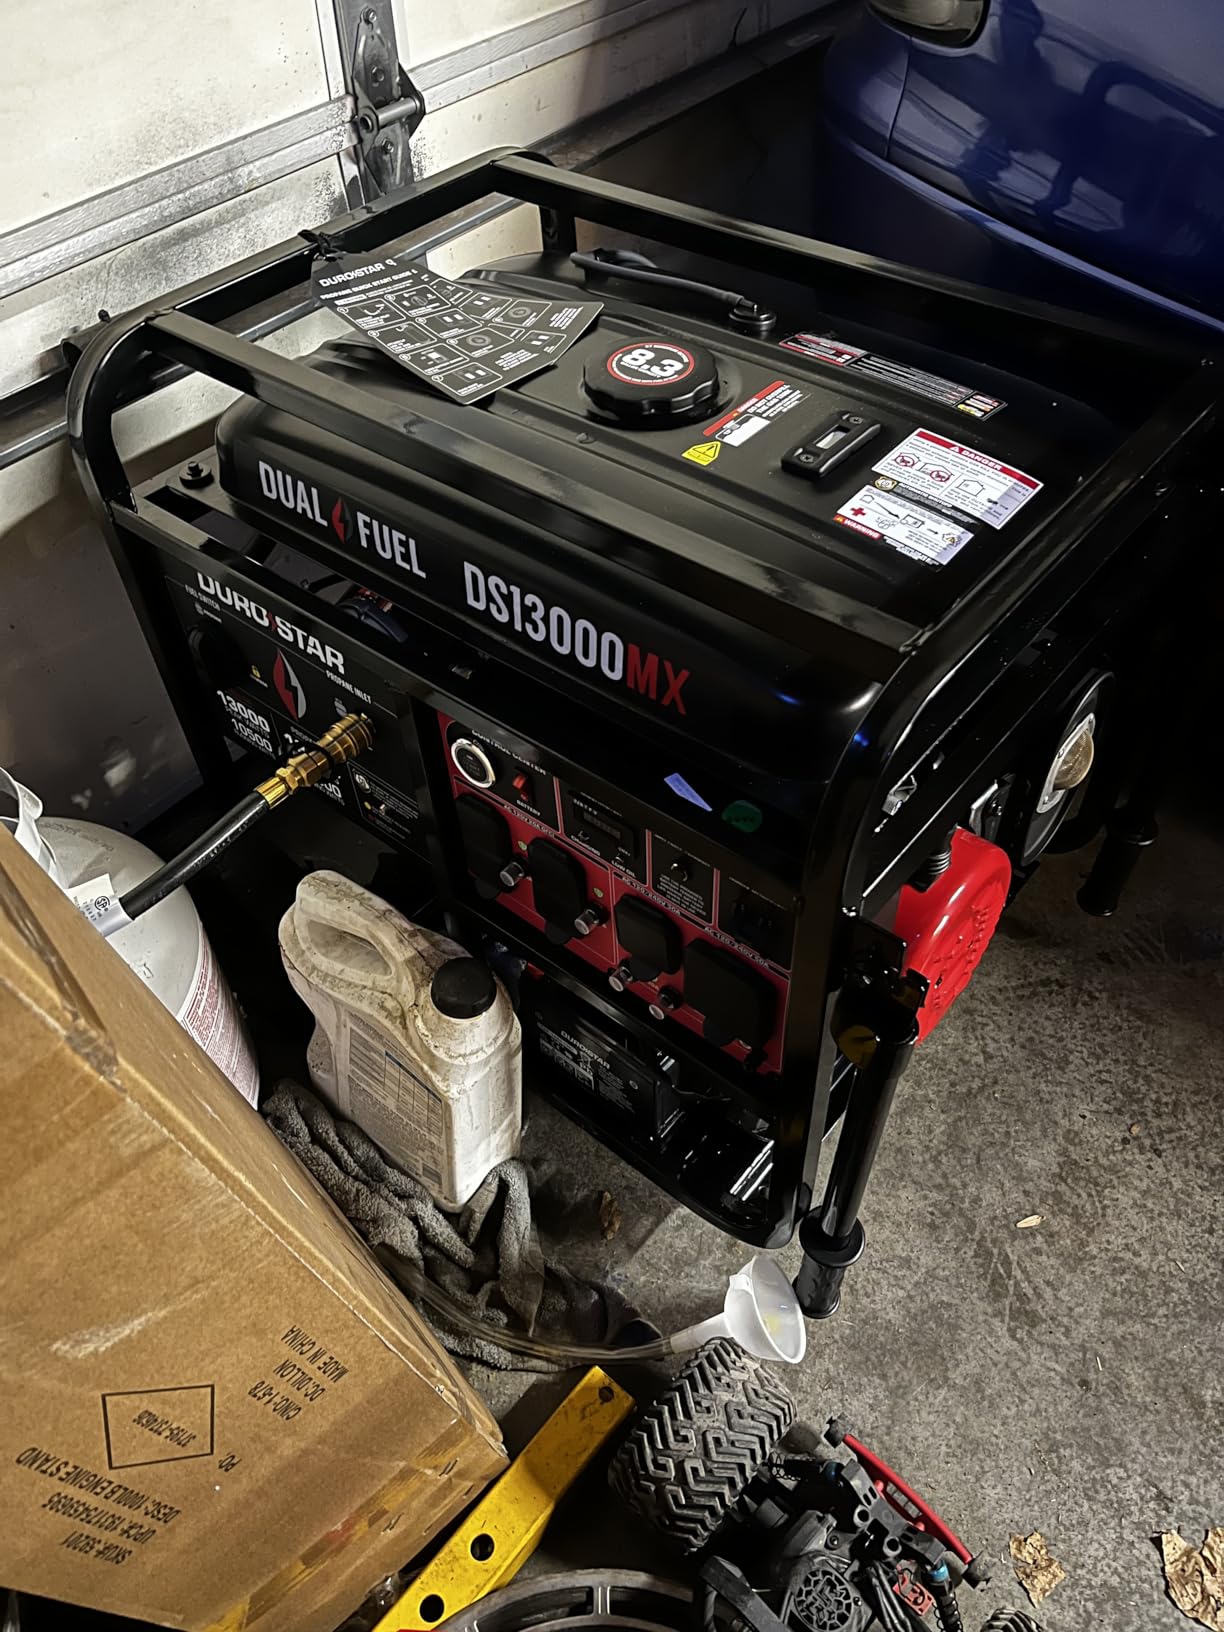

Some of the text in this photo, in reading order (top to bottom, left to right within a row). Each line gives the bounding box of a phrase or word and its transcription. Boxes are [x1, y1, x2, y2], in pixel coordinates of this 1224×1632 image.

[621, 348, 683, 377] 8.3
[961, 449, 1002, 471] DANGER
[259, 460, 425, 579] DUAL FUEL
[842, 519, 880, 538] WARNING
[464, 559, 691, 716] DS13000MX
[218, 688, 269, 733] 13000
[280, 1324, 349, 1383] MADE IN CHINA
[247, 1379, 279, 1406] 1-678
[272, 1358, 325, 1401] DC: DILLON
[14, 1445, 68, 1478] STAND
[218, 1451, 241, 1473] PO:
[61, 1464, 112, 1497] ENGINE
[143, 1499, 180, 1524] DESC:
[60, 1530, 101, 1555] 59201
